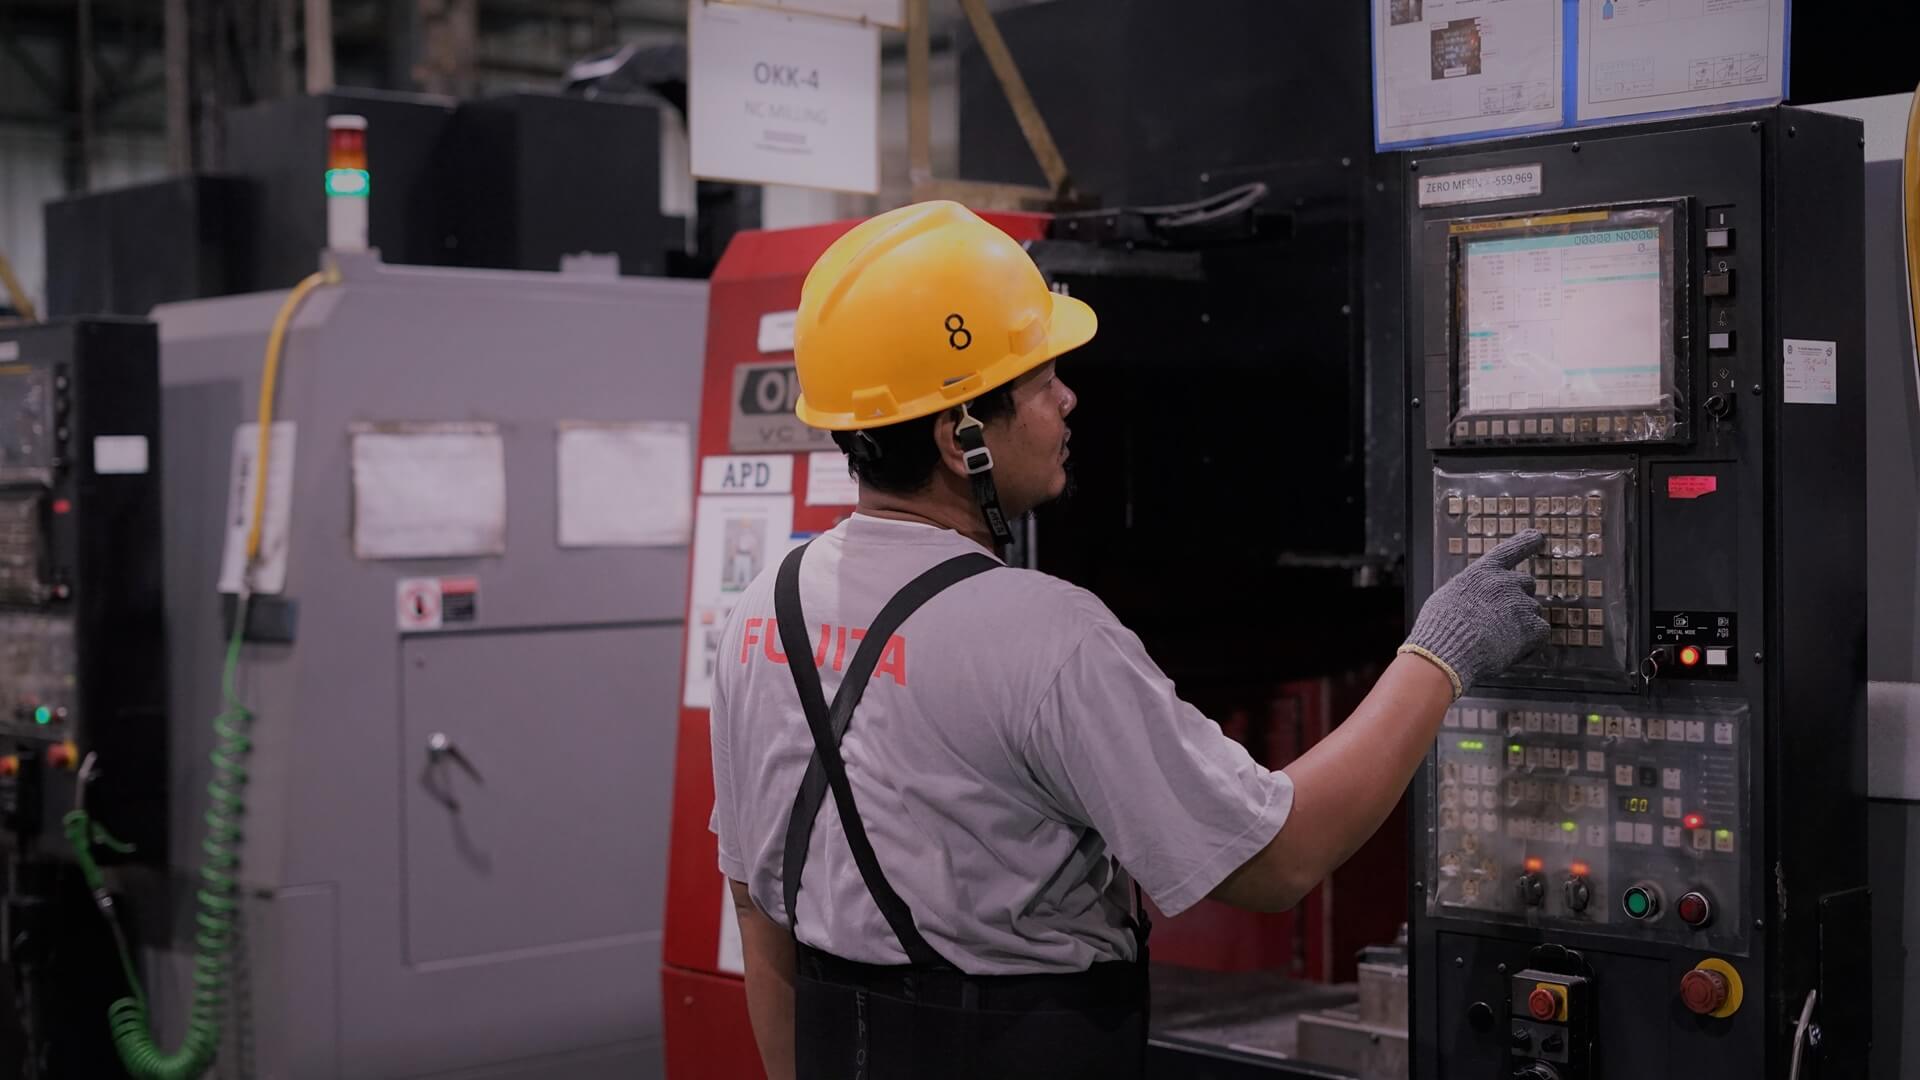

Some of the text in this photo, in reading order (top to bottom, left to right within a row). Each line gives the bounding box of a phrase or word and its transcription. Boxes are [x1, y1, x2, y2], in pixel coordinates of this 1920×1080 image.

[754, 61, 820, 89] OKK-4
[1425, 180, 1450, 193] ZERO
[944, 313, 972, 351] 8
[722, 461, 770, 487] APD
